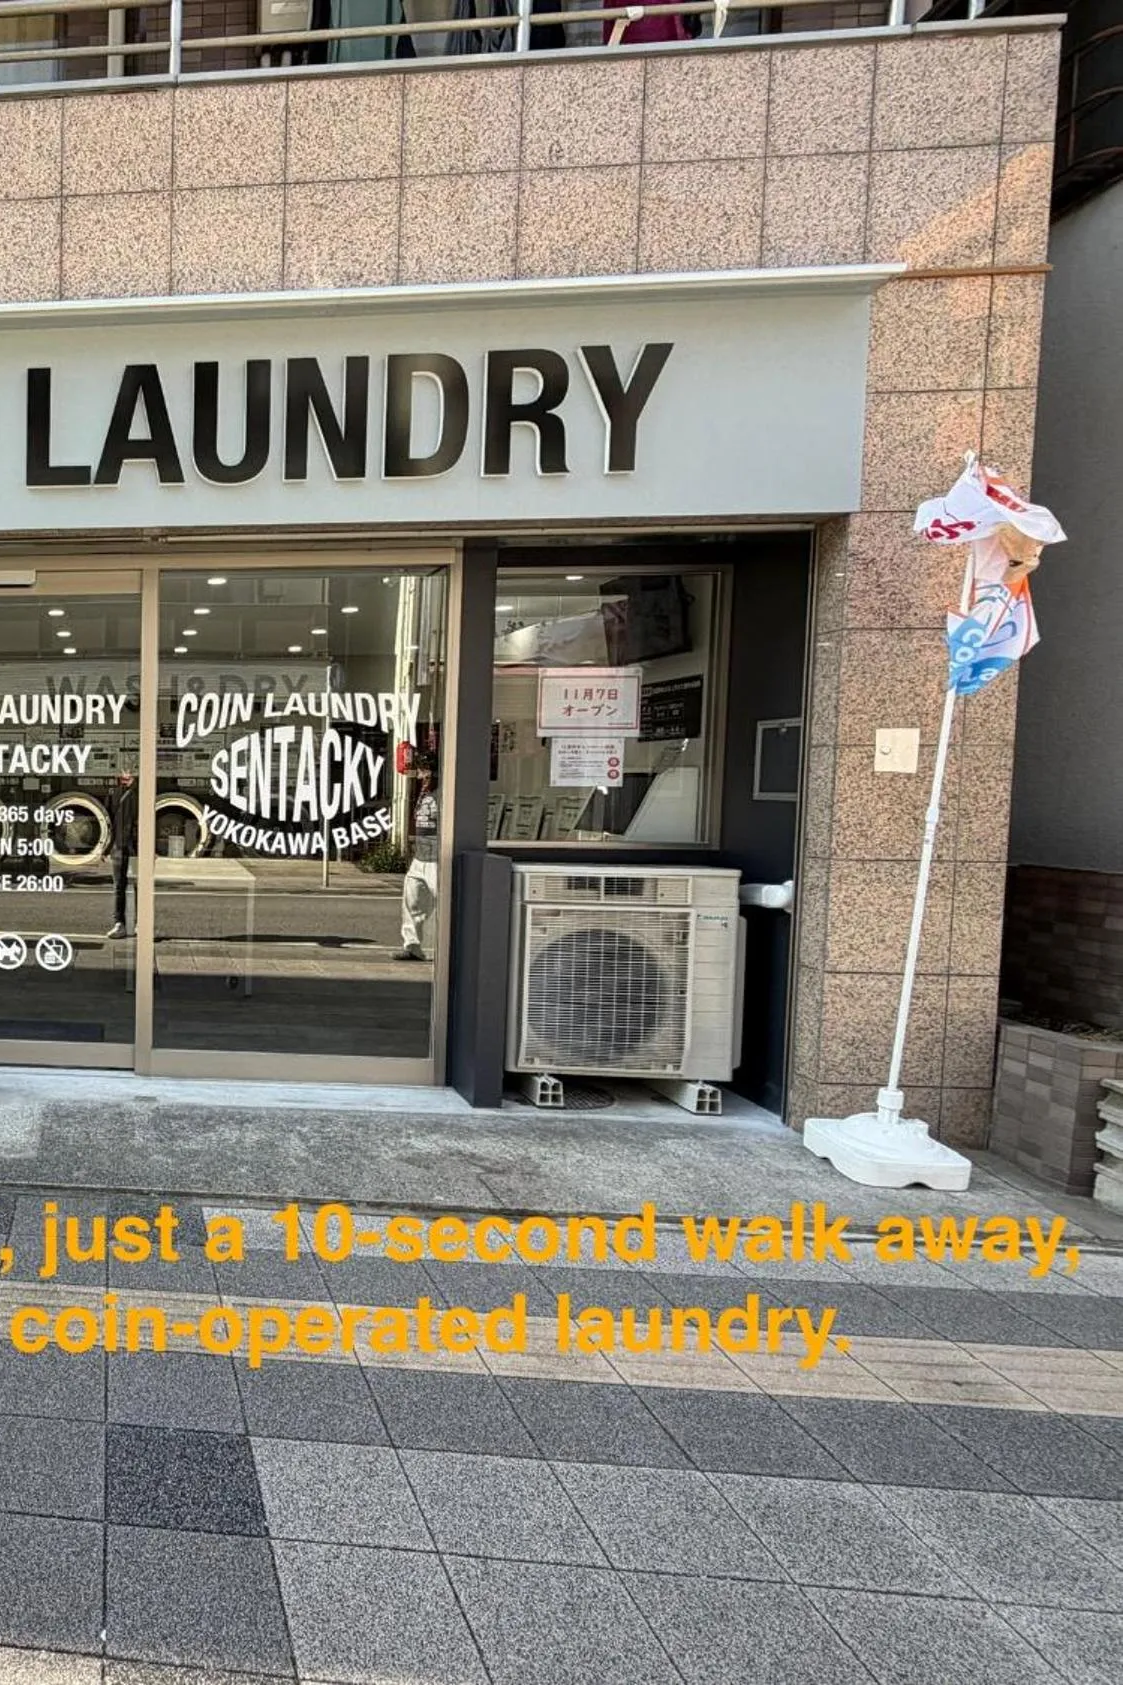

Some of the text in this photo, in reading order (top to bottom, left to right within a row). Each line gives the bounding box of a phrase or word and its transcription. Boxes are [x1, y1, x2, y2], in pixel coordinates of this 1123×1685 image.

[25, 342, 675, 488] LAUNDRY
[175, 692, 422, 749] COIN LAUNDRY
[562, 704, 618, 717] オープン
[210, 725, 385, 822] SENTACKY
[33, 805, 75, 827] days
[198, 803, 394, 856] YOKOKAWA BASE
[17, 838, 54, 856] 5:00
[16, 874, 64, 893] 26:00
